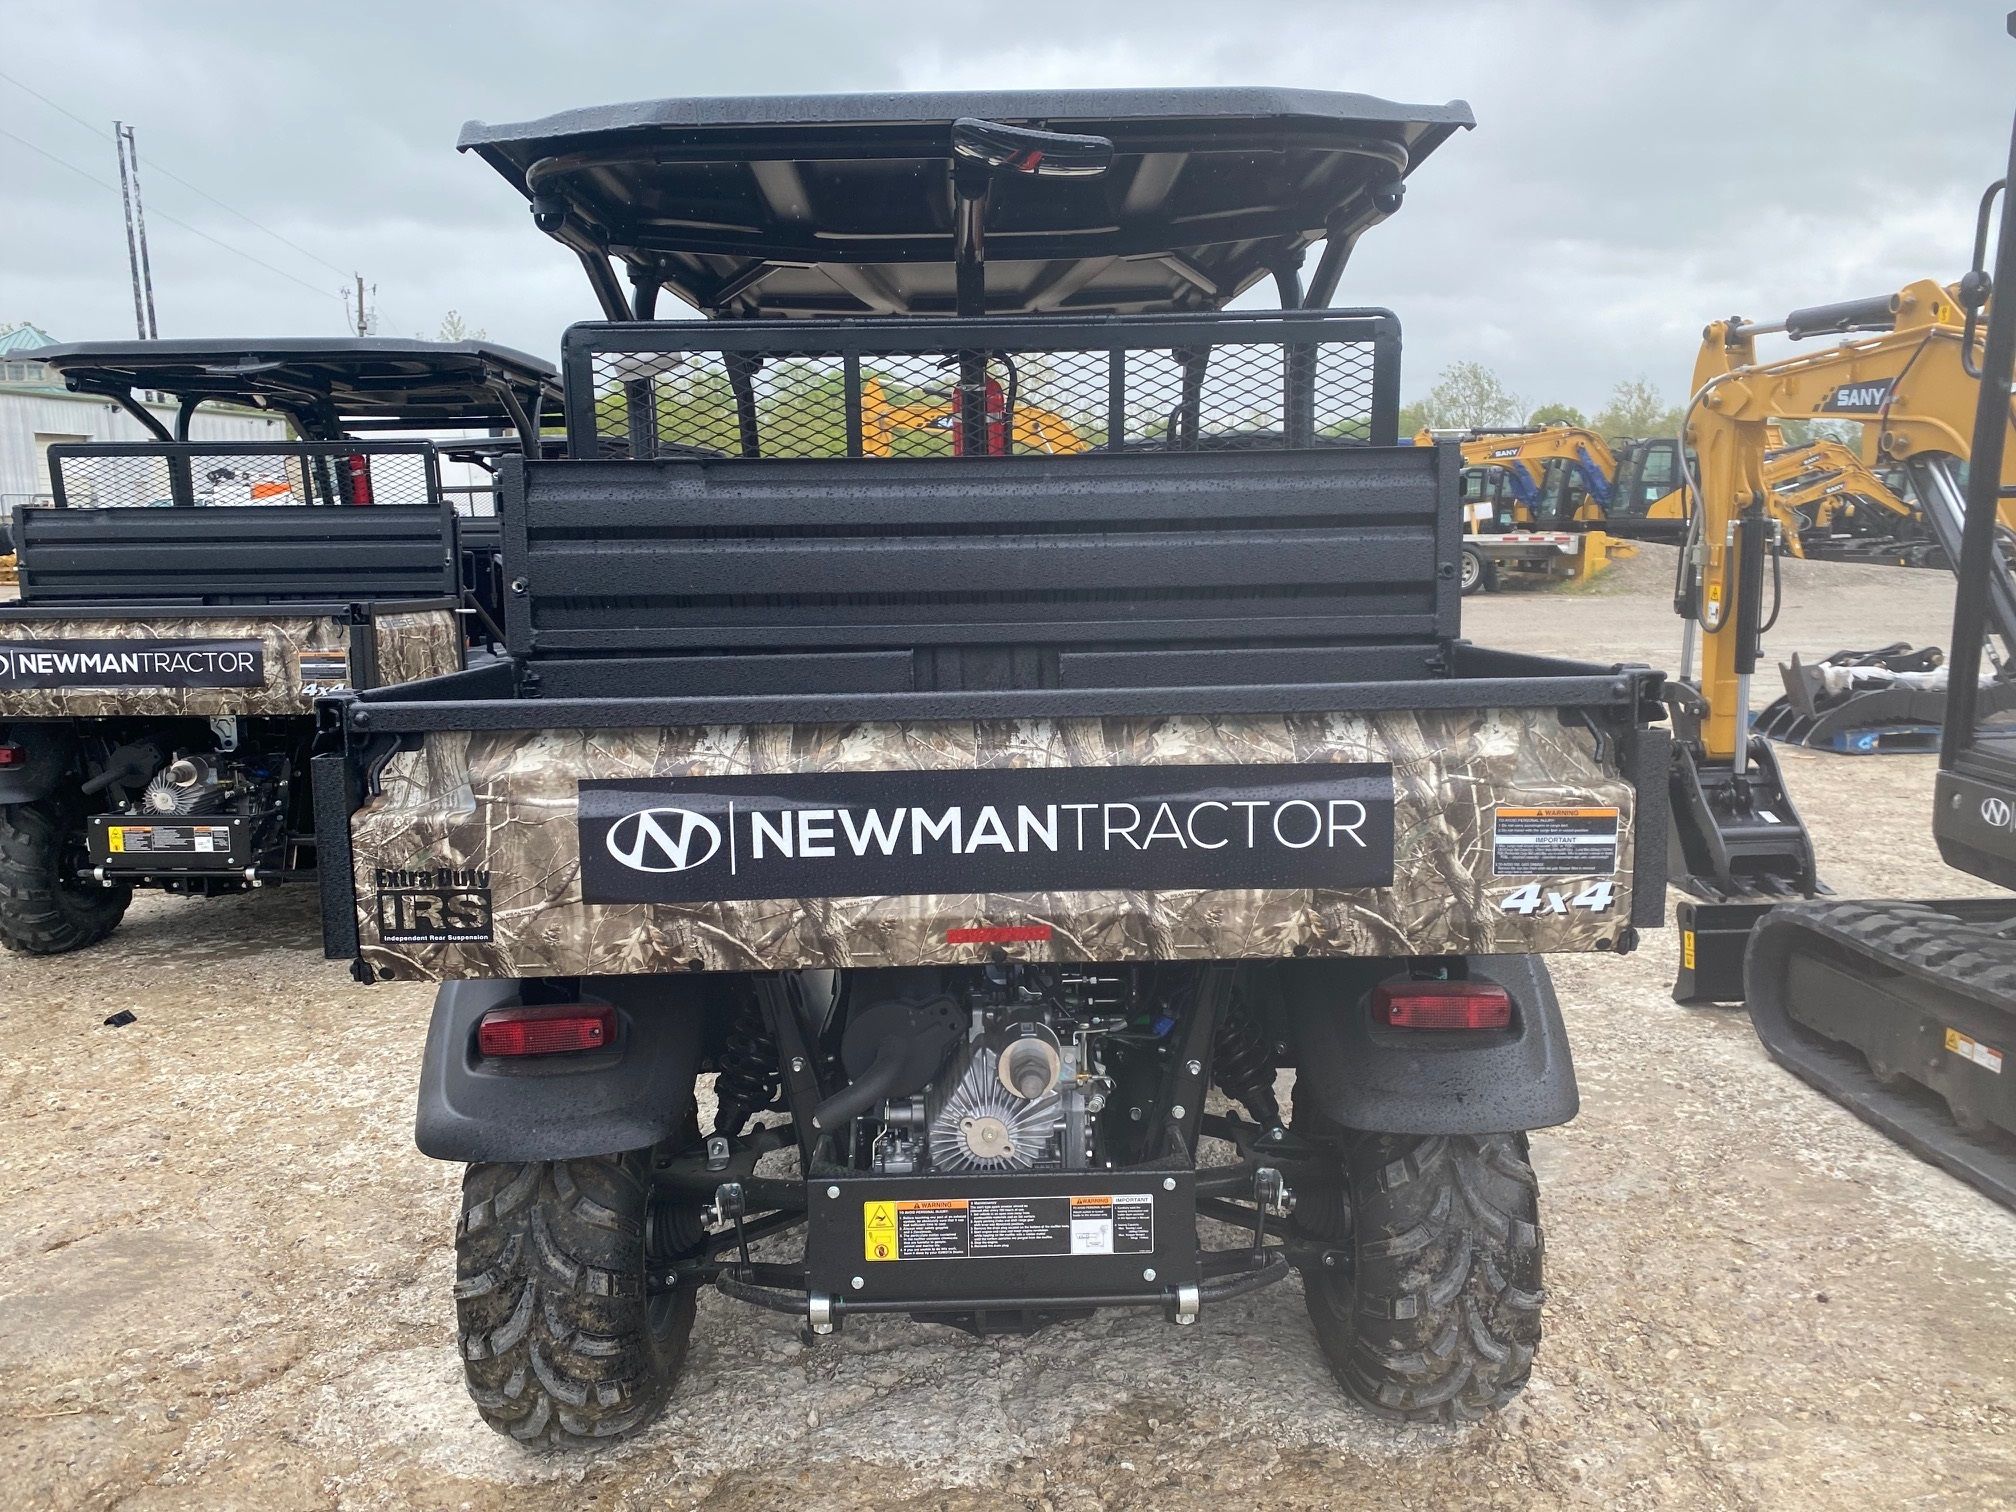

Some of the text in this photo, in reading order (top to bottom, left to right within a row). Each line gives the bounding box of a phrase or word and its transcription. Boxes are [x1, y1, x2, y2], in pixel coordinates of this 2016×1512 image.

[1837, 388, 1885, 406] SANY
[1495, 449, 1518, 457] SANY
[376, 868, 489, 888] Extra Duty
[1500, 881, 1614, 915] 4x4
[381, 894, 488, 930] IRS
